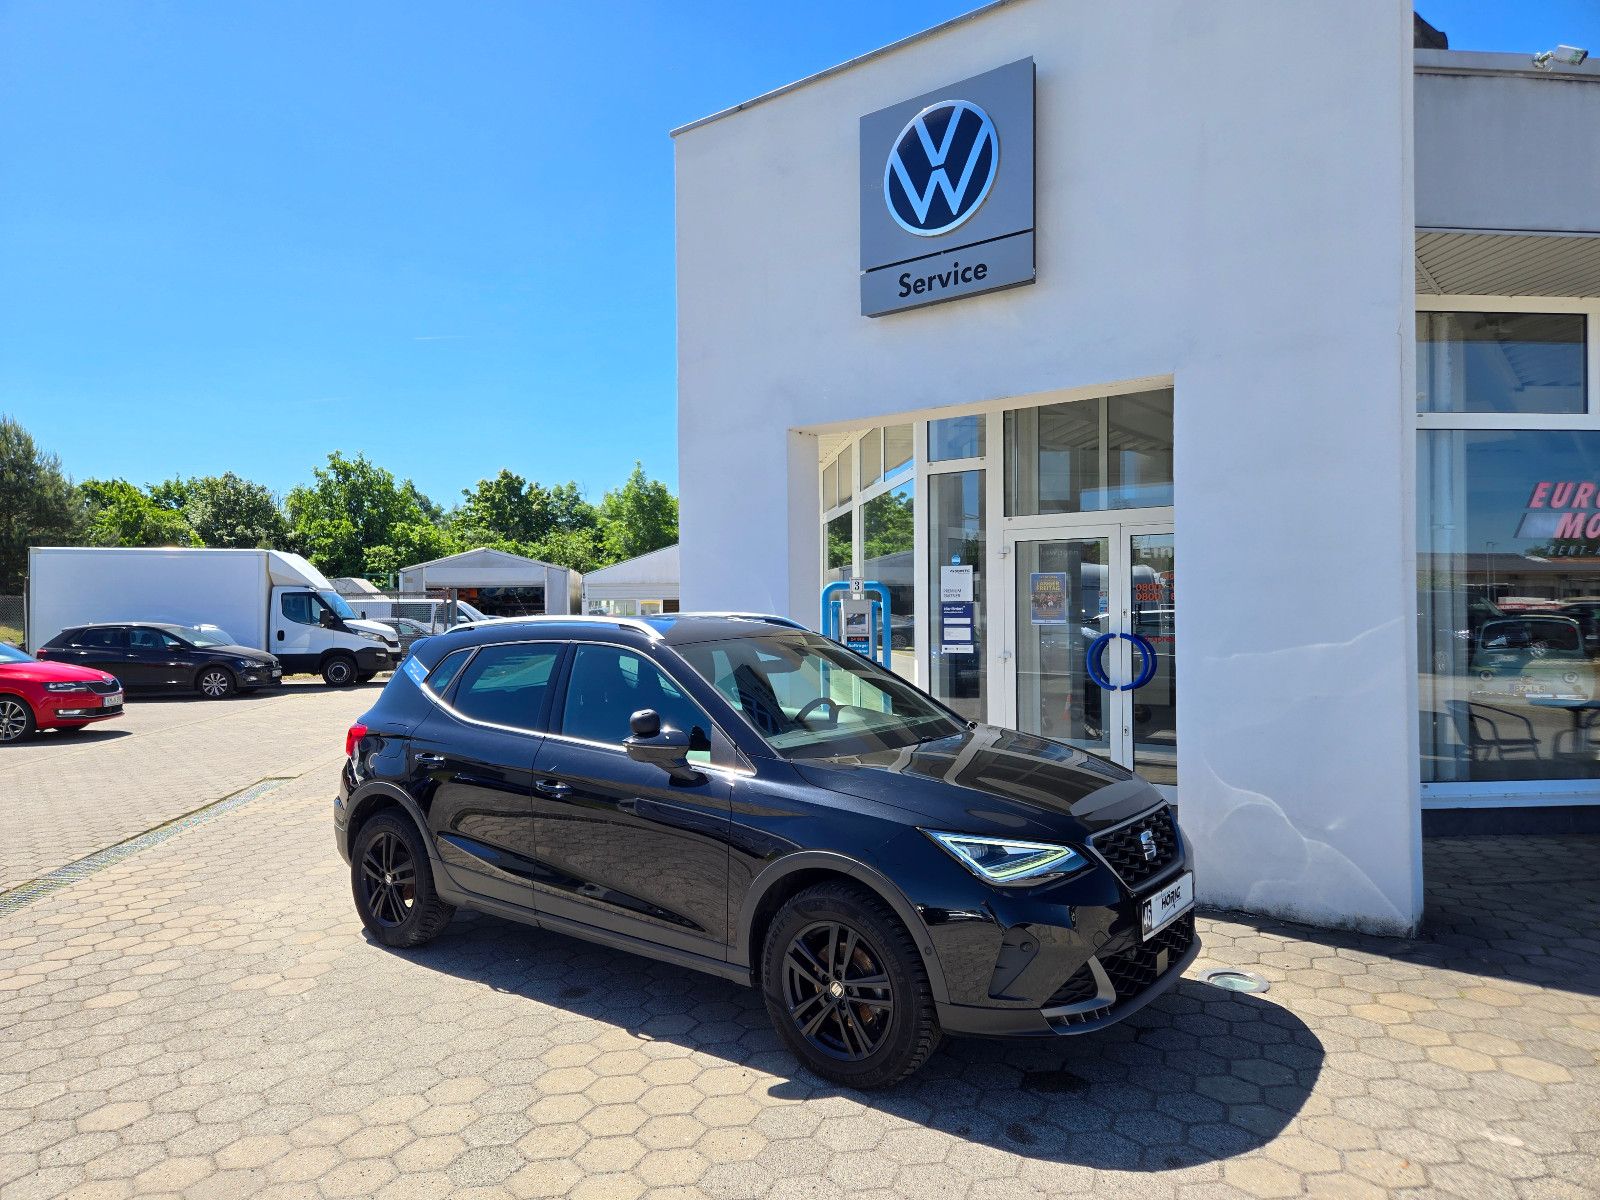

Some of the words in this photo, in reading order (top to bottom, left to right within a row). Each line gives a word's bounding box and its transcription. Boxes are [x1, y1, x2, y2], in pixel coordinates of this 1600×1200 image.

[898, 261, 988, 297] Service
[1527, 481, 1600, 510] EUR
[854, 580, 860, 591] 3
